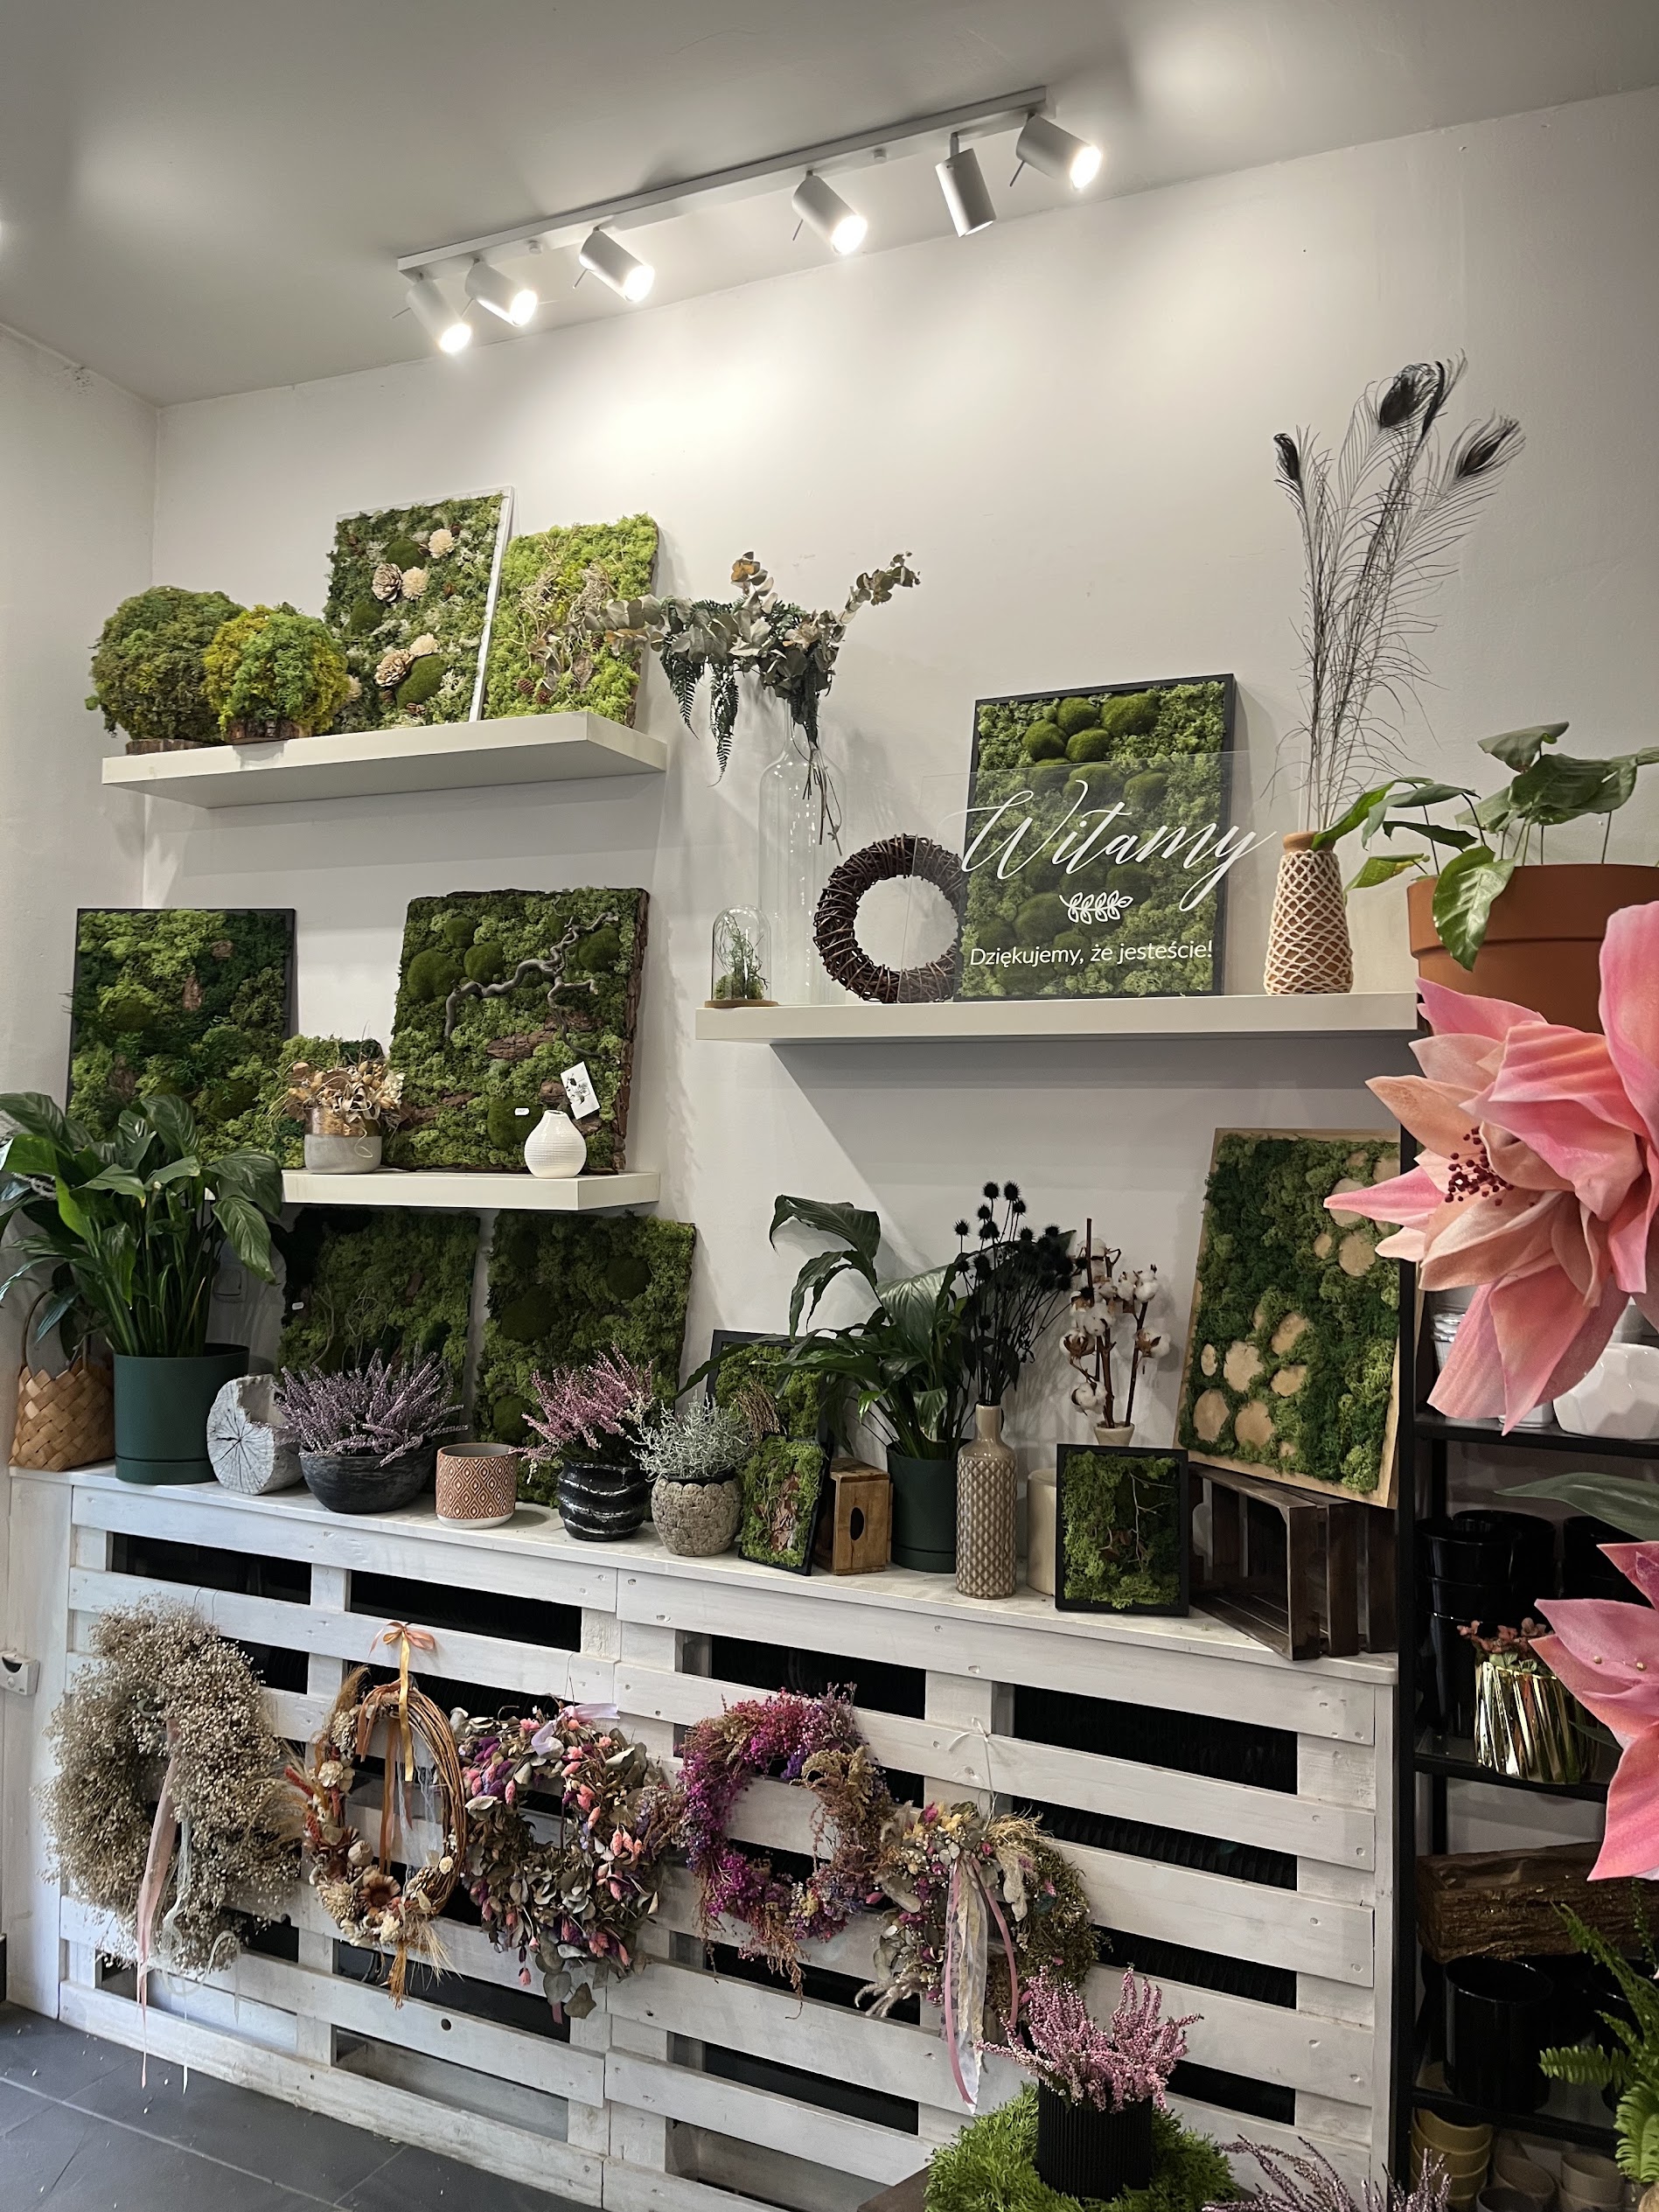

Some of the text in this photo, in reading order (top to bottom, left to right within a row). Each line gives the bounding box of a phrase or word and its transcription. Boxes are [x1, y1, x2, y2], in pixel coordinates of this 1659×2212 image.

[937, 779, 1278, 912] Witamy
[970, 939, 1213, 968] Dziękujemy, że jesteście!
